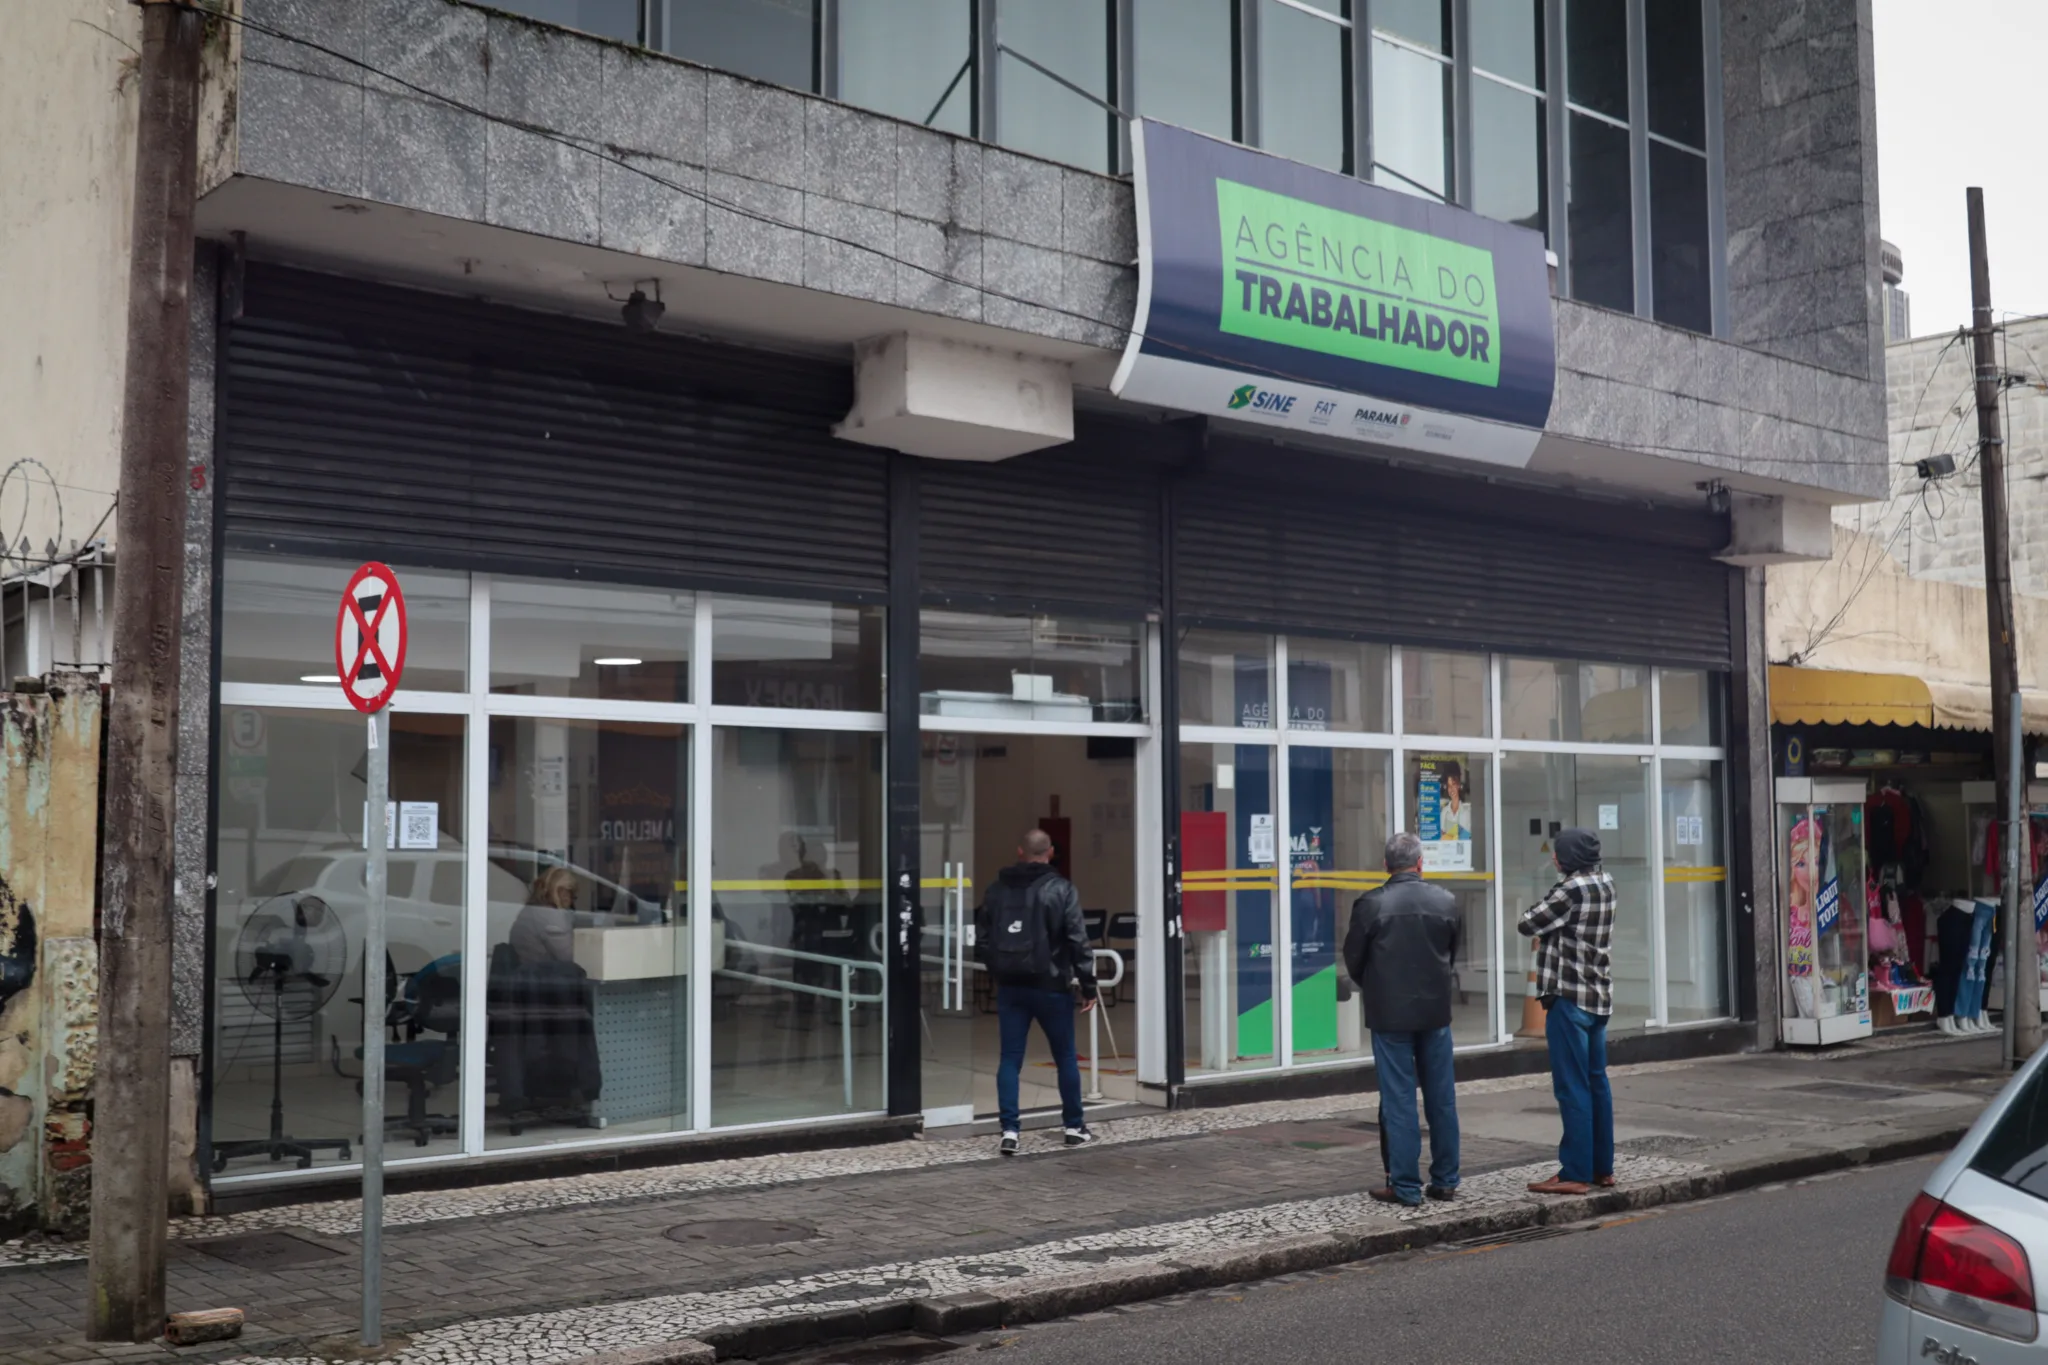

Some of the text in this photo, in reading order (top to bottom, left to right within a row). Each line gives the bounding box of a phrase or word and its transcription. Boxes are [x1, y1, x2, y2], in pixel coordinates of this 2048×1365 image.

[1236, 214, 1485, 308] AGÊNCIA DO
[1235, 268, 1490, 364] TRABALHADOR
[1314, 400, 1338, 417] FAT
[1355, 408, 1399, 426] PARANÁ
[1307, 707, 1325, 720] DO
